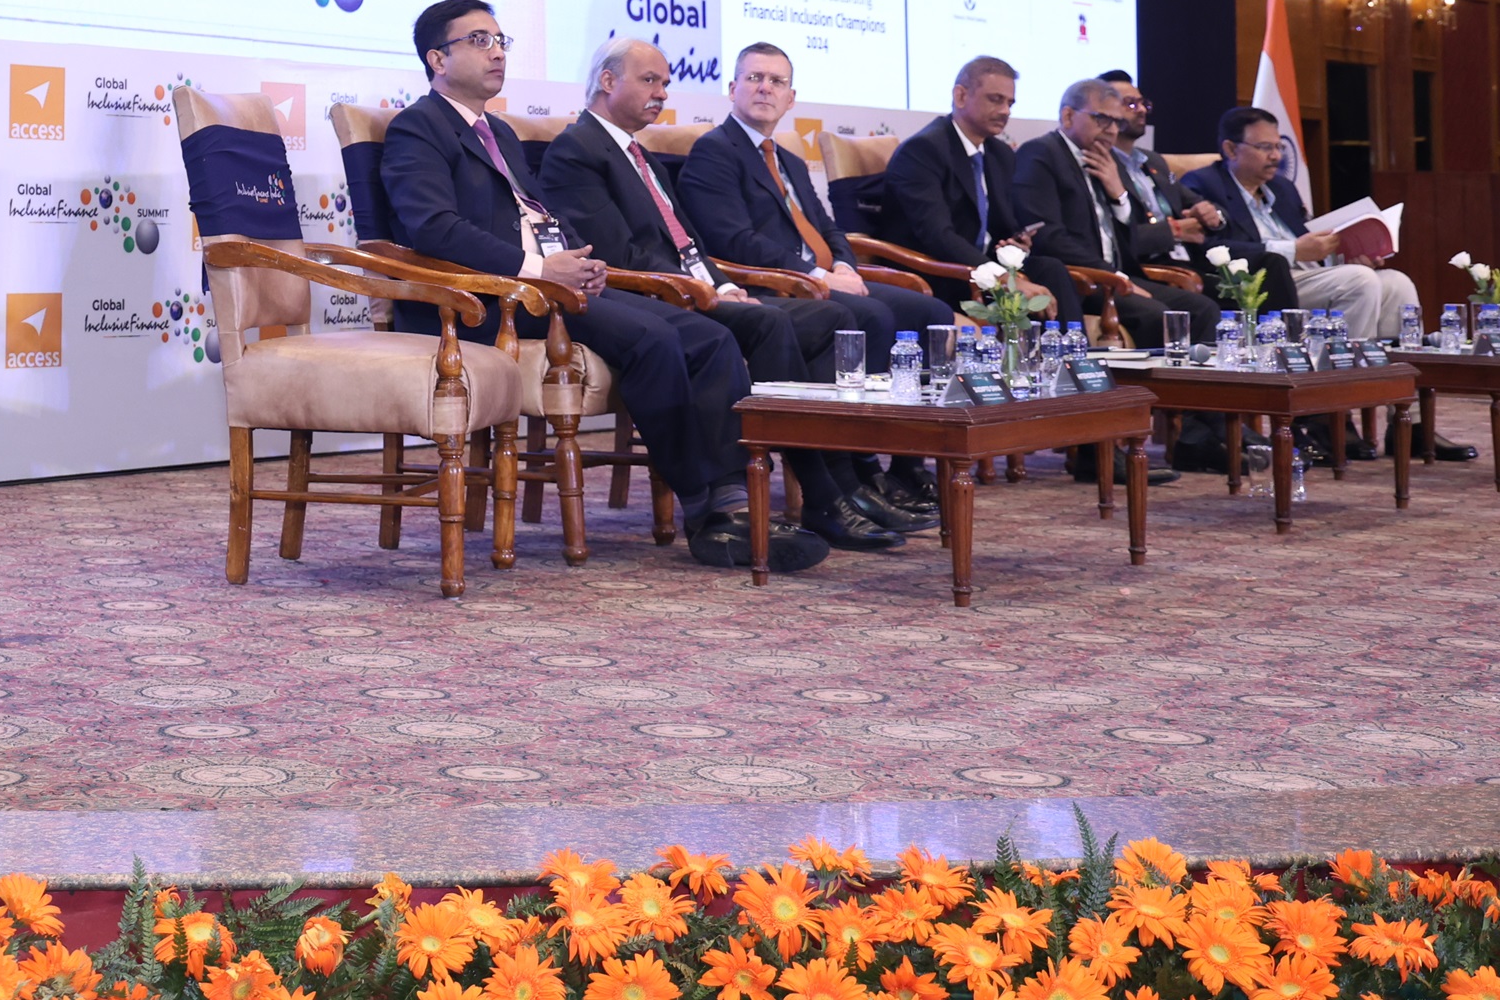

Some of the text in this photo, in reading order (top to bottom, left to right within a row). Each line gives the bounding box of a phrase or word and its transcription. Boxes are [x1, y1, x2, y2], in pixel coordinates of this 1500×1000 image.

[743, 2, 886, 35] Financial Inclusion Champions
[806, 36, 829, 53] 2024
[95, 77, 128, 90] Global
[331, 92, 358, 104] Global
[527, 105, 550, 116] Global
[10, 123, 63, 140] access
[17, 183, 52, 196] Global
[137, 208, 169, 218] SUMMIT
[92, 299, 125, 311] Global
[330, 294, 357, 306] Global
[7, 352, 60, 368] access
